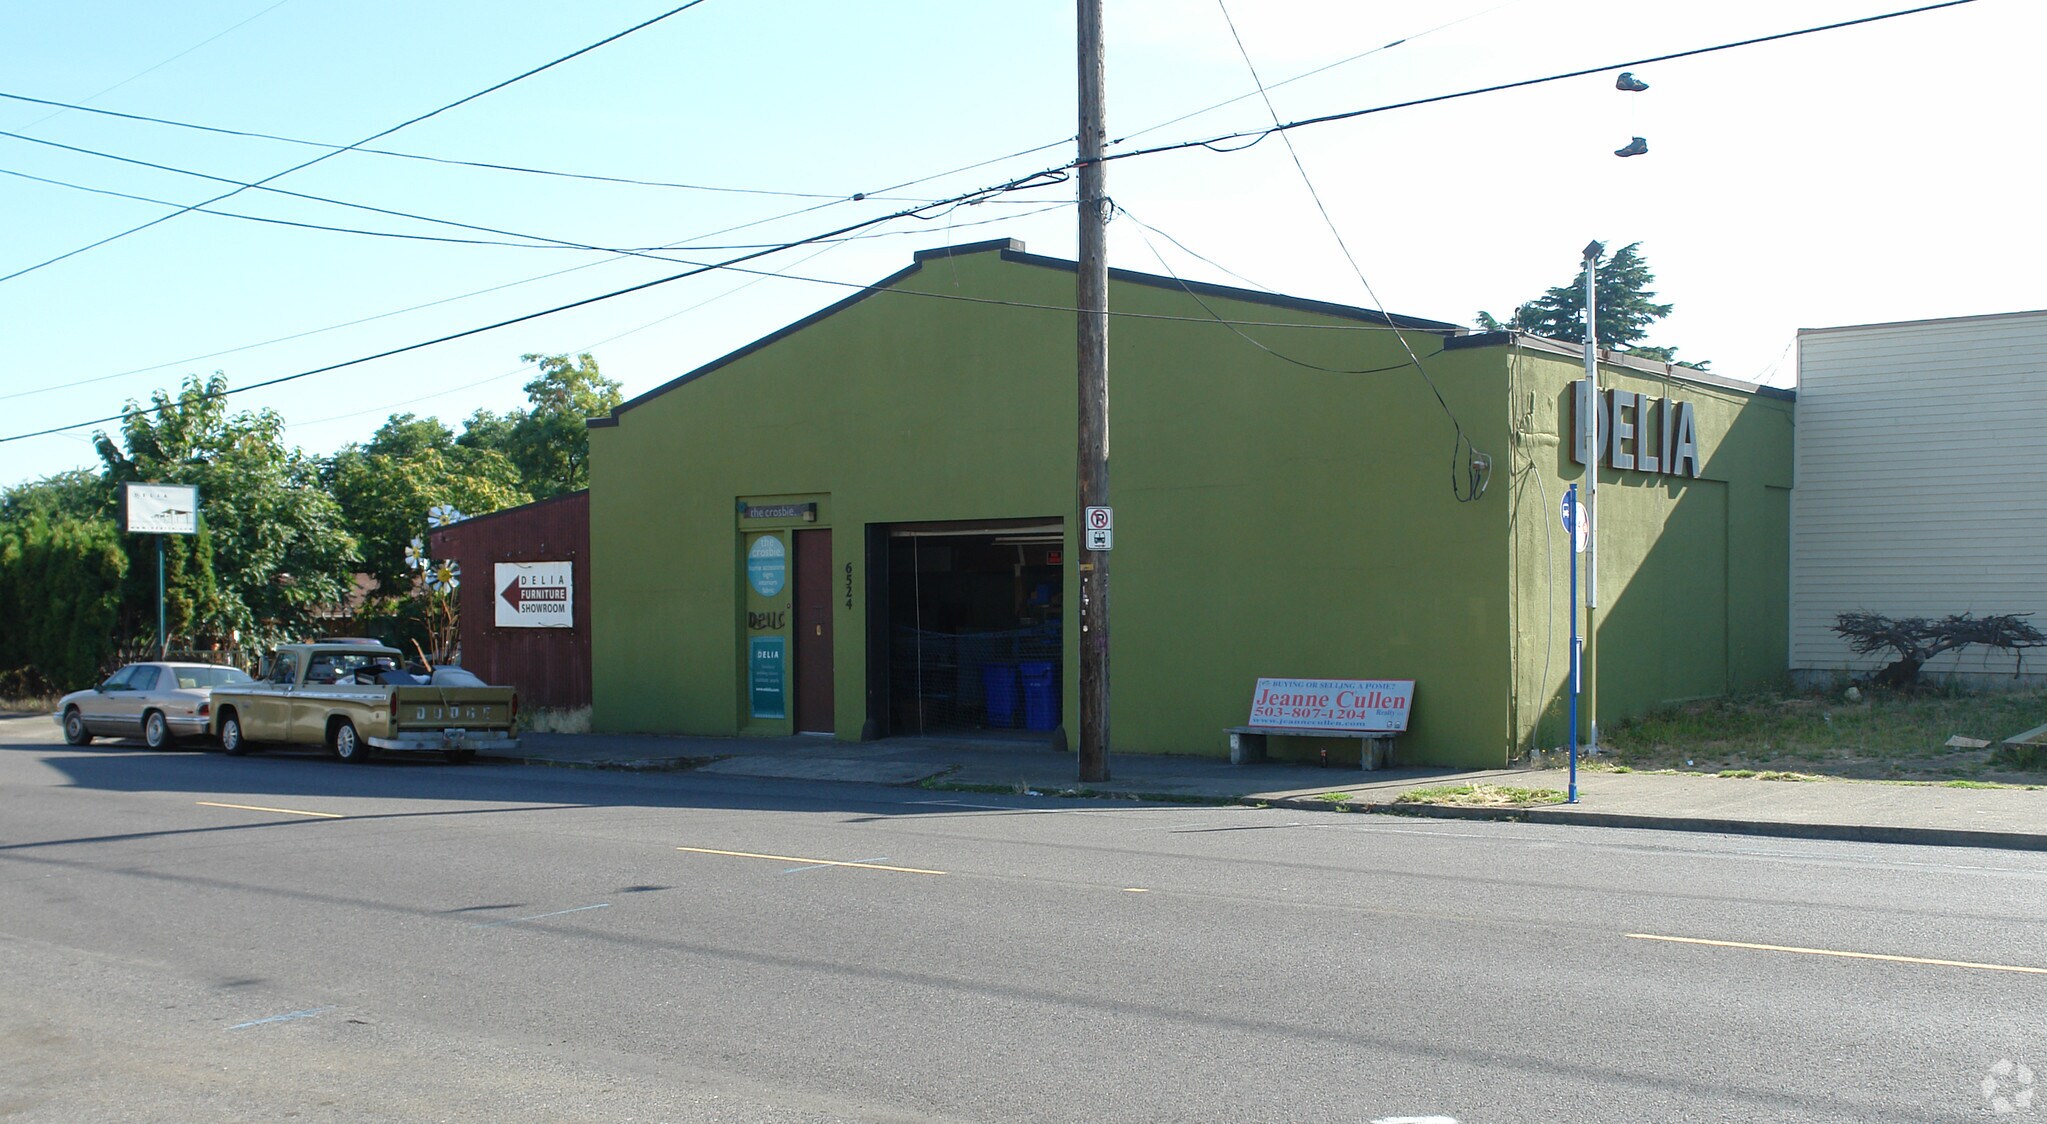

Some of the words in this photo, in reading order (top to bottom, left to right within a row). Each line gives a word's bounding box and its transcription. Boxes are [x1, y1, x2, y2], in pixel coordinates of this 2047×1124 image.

[1570, 380, 1700, 478] DELIA
[750, 507, 764, 518] the
[521, 575, 565, 585] DELIA
[845, 561, 853, 611] 6524
[521, 589, 565, 600] FURNITURE
[521, 604, 565, 613] SHOWROOM
[757, 651, 779, 659] DELIA
[1320, 682, 1355, 690] SELLING
[1256, 689, 1330, 708] Jeanne
[1336, 690, 1406, 710] Cullen
[1254, 706, 1367, 720] 503-807-1204
